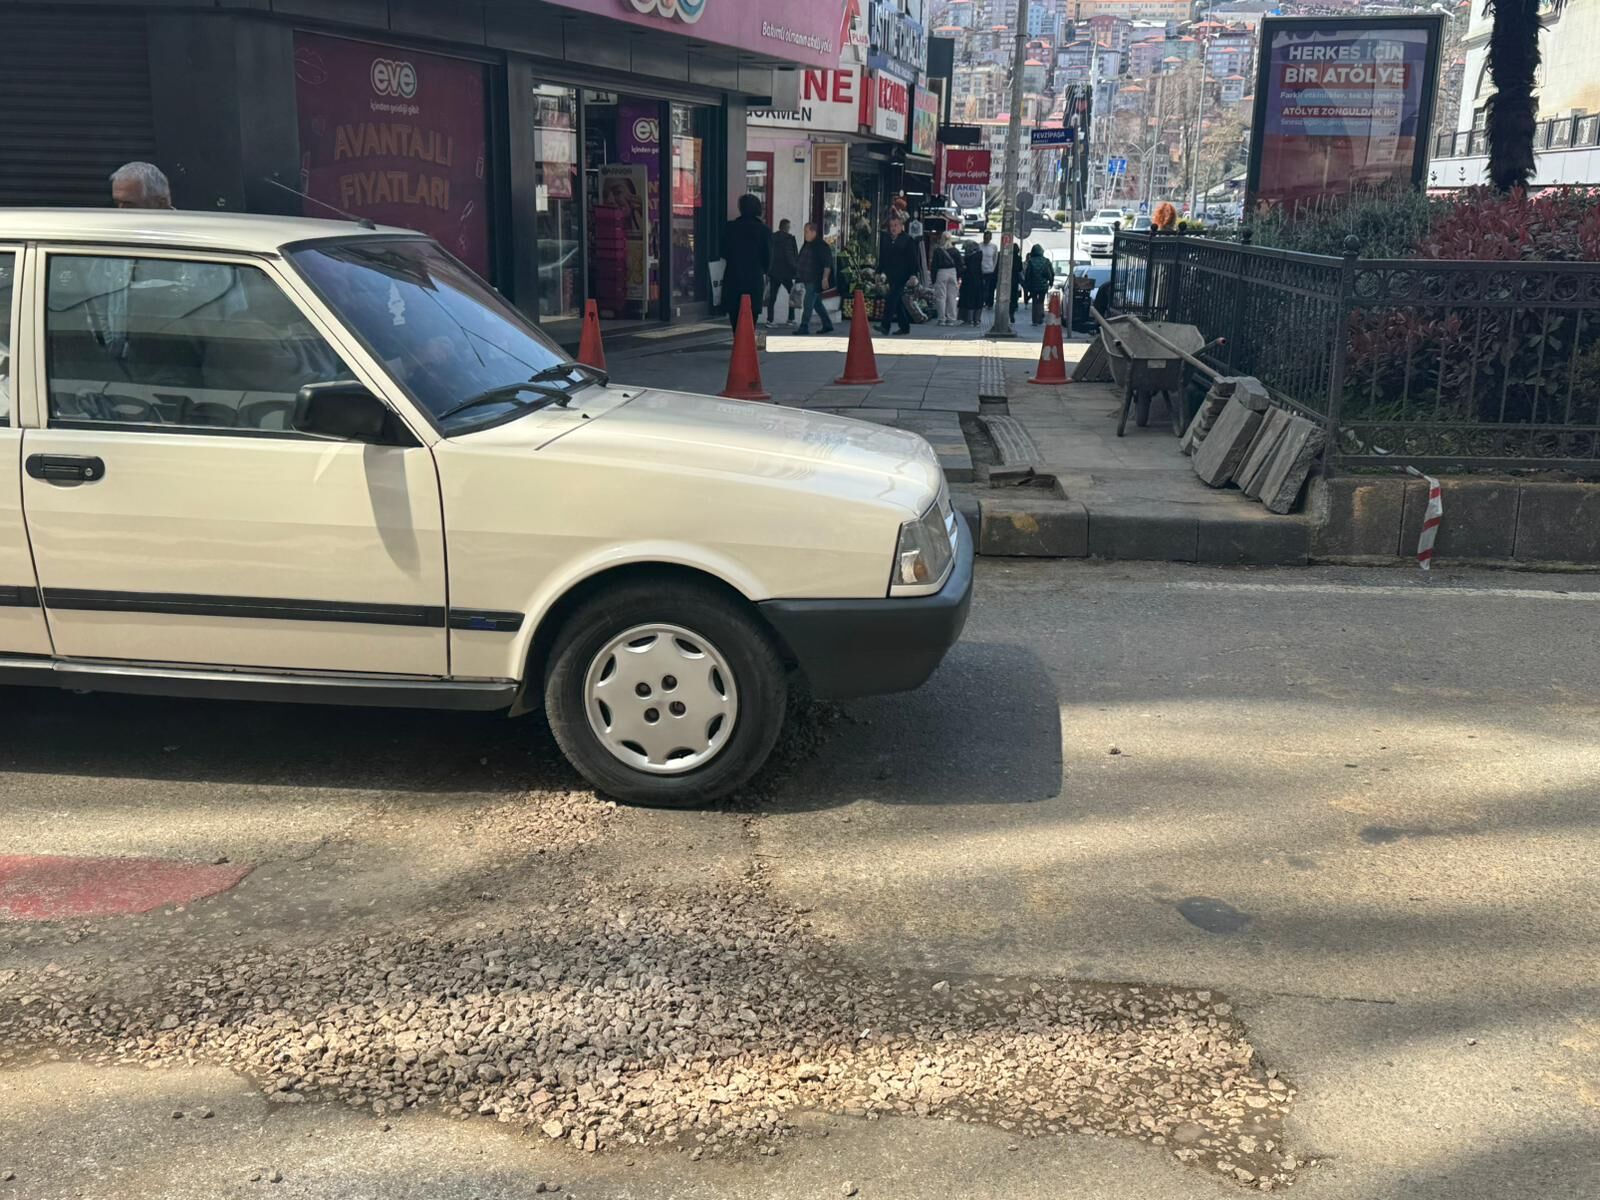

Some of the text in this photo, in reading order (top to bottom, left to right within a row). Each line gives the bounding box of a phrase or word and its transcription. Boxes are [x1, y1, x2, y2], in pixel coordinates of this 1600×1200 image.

[1289, 41, 1404, 63] HERKES İÇİN
[370, 57, 417, 98] eve
[802, 67, 853, 103] NE
[1284, 64, 1405, 83] BİR ATÖLYE
[1283, 105, 1320, 116] ATÖLYE
[1321, 107, 1382, 116] ZONGULDAK
[633, 118, 659, 143] ev
[1033, 131, 1065, 140] FEVZİPAŞA
[334, 123, 452, 167] AVANTAJLI
